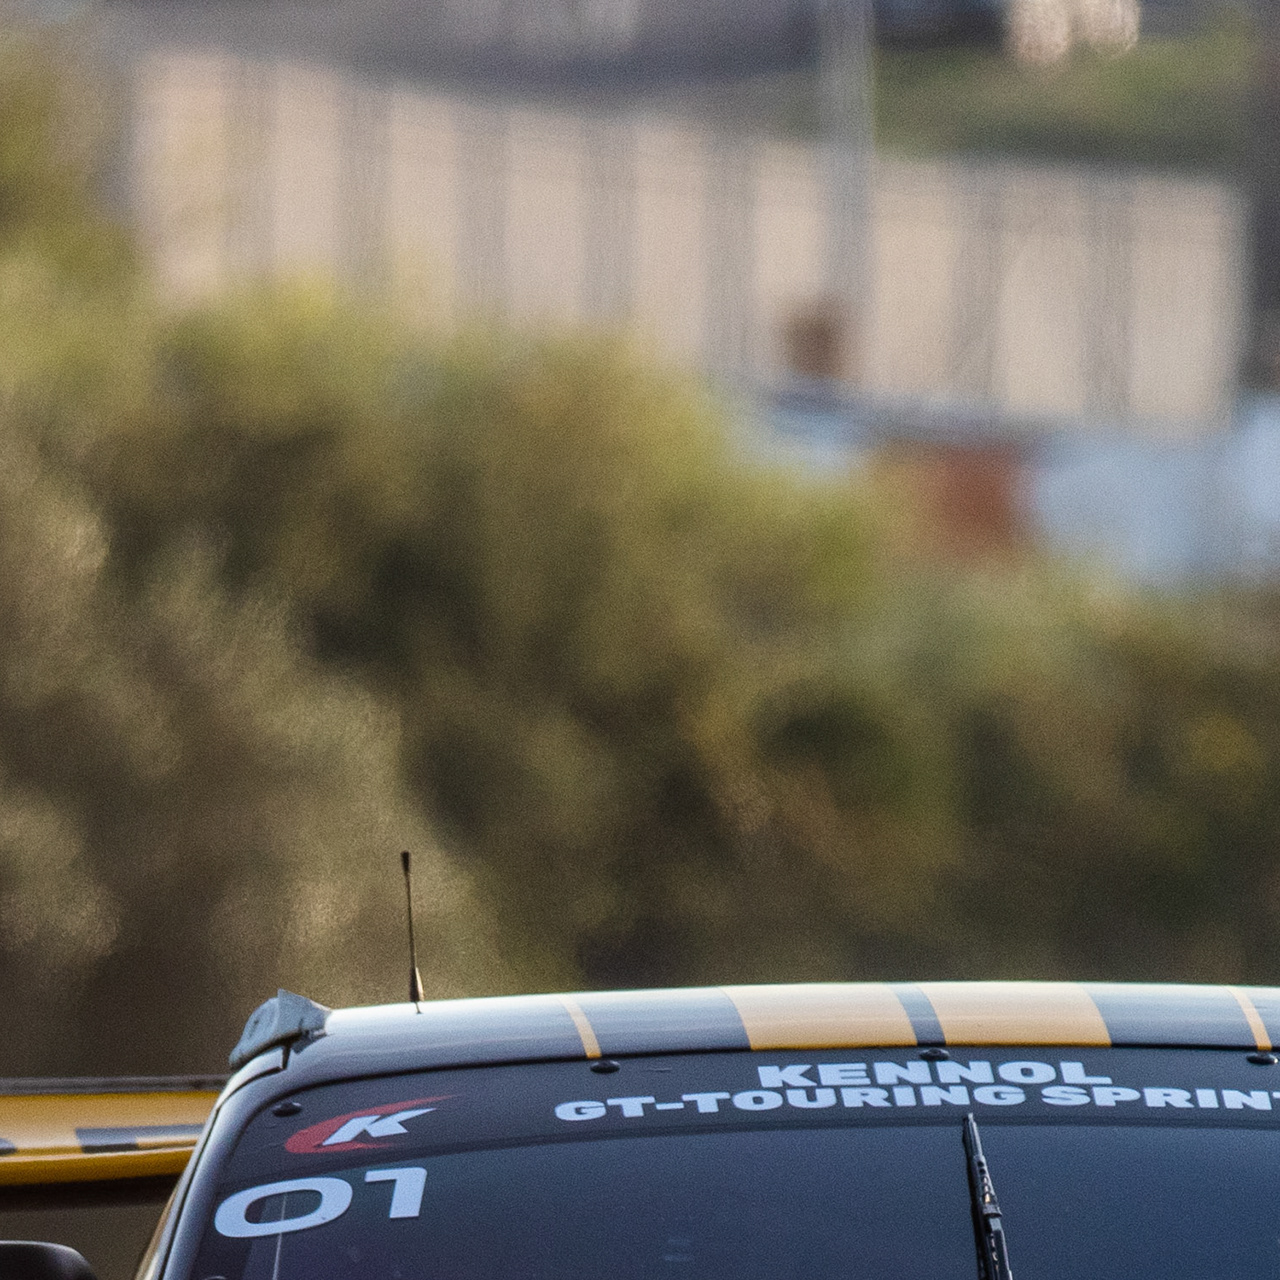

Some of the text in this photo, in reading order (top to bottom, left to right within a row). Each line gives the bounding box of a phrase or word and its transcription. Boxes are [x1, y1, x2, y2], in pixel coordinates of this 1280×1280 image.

[757, 1060, 1112, 1088] KENNOL
[554, 1085, 1026, 1121] GT-TOURING
[214, 1166, 428, 1239] 01
